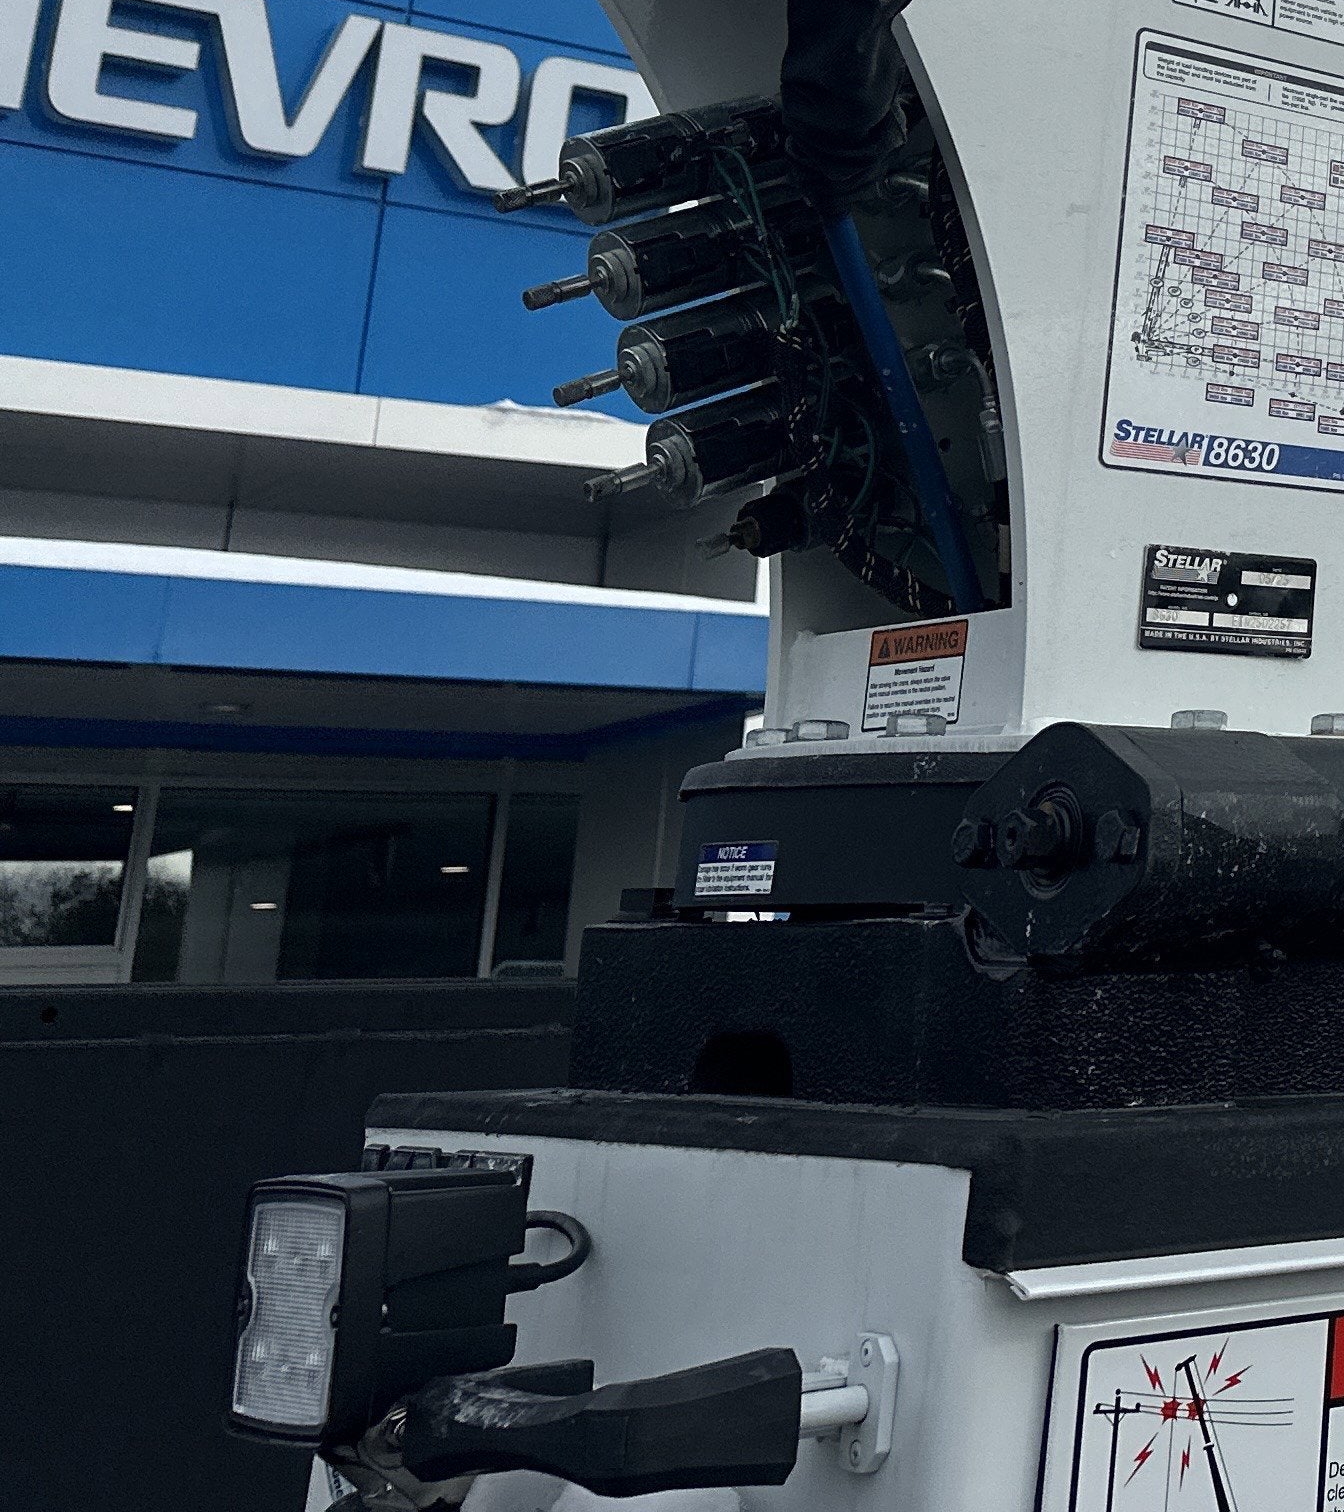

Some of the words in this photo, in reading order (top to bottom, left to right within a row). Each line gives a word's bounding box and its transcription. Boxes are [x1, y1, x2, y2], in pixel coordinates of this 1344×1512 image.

[1114, 418, 1206, 451] STELLAR
[1208, 437, 1280, 471] 8630
[1154, 549, 1223, 573] STELLAR
[893, 630, 959, 655] WARNING
[717, 845, 749, 861] NOTICE
